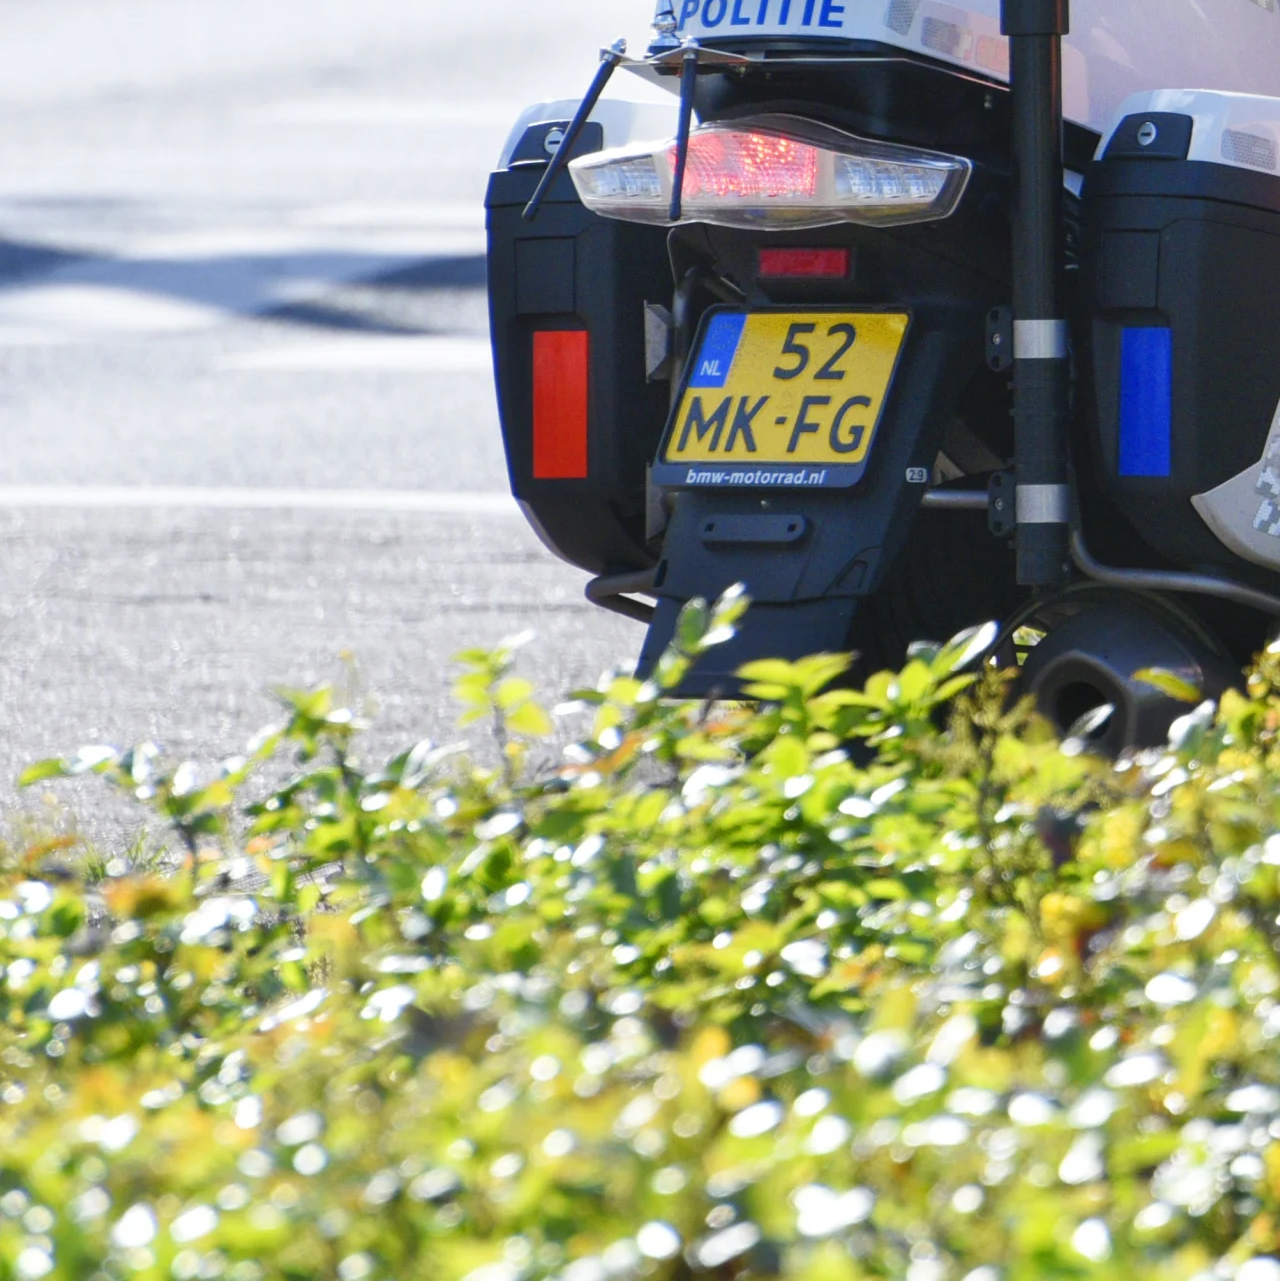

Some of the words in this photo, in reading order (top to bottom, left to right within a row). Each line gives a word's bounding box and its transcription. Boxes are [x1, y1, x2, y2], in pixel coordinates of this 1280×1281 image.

[700, 360, 721, 376] NL
[773, 323, 857, 380] 52
[676, 395, 871, 454] MK-FG
[685, 468, 827, 486] bmw-motorrad.nl
